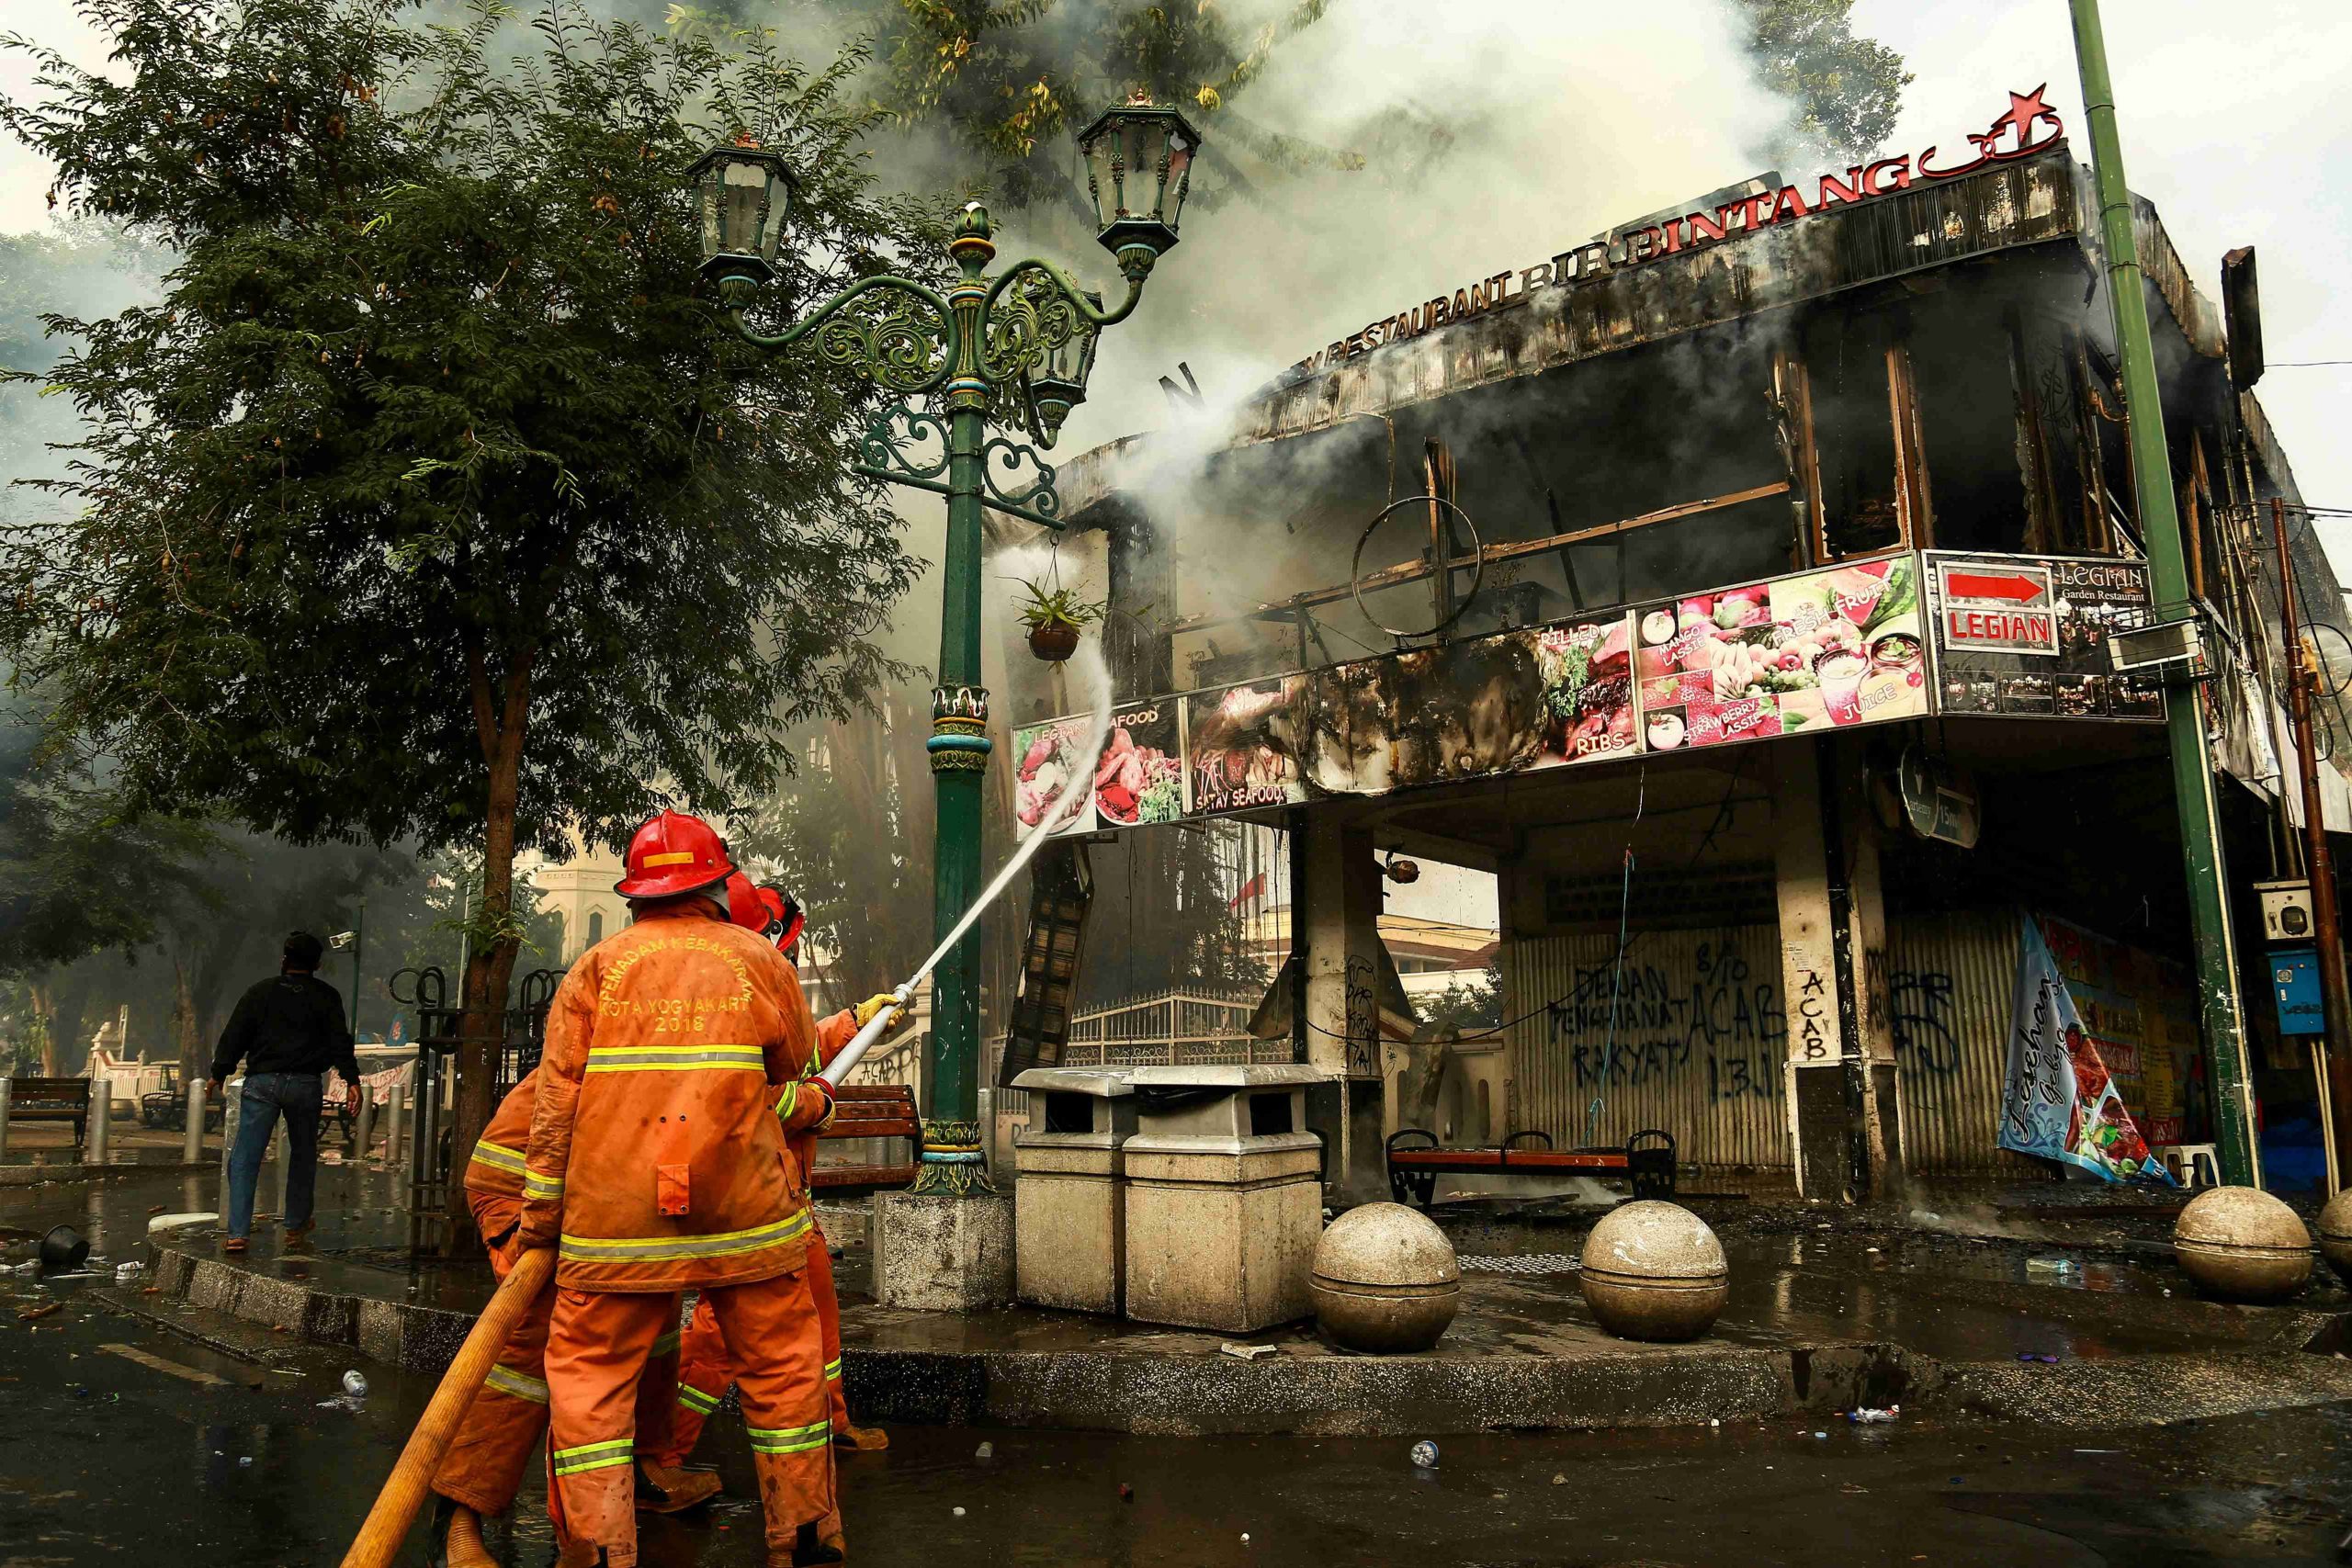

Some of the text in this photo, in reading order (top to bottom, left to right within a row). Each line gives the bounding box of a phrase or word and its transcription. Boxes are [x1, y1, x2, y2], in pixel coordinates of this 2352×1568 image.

[1323, 153, 1911, 369] RESTAURANT BIR BINTANG
[2060, 564, 2144, 590] LEGIAN
[2062, 588, 2146, 603] Garden Restaurant
[1771, 576, 1894, 648] FRESH FRUIT
[1950, 611, 2051, 644] LEGIAN
[1540, 624, 1601, 646] RILLED
[1657, 626, 1701, 656] MANGO
[1662, 635, 1706, 667] LASSIE
[1842, 682, 1899, 721] JUICE
[1034, 722, 1087, 744] LEGIAN
[1683, 701, 1758, 742] STRAWBERRY
[1718, 712, 1763, 740] LASSIE
[1576, 731, 1627, 756] RIBS
[1196, 786, 1283, 811] SATAY SEAFOOD
[599, 935, 755, 1003] PEMADAM KEBAKARAN
[599, 999, 643, 1017] KOTA
[1799, 972, 1826, 1060] ACAB
[1680, 984, 1788, 1064] ACAB
[862, 1057, 897, 1083] ACAB
[1573, 1036, 1680, 1089] RAKYAT
